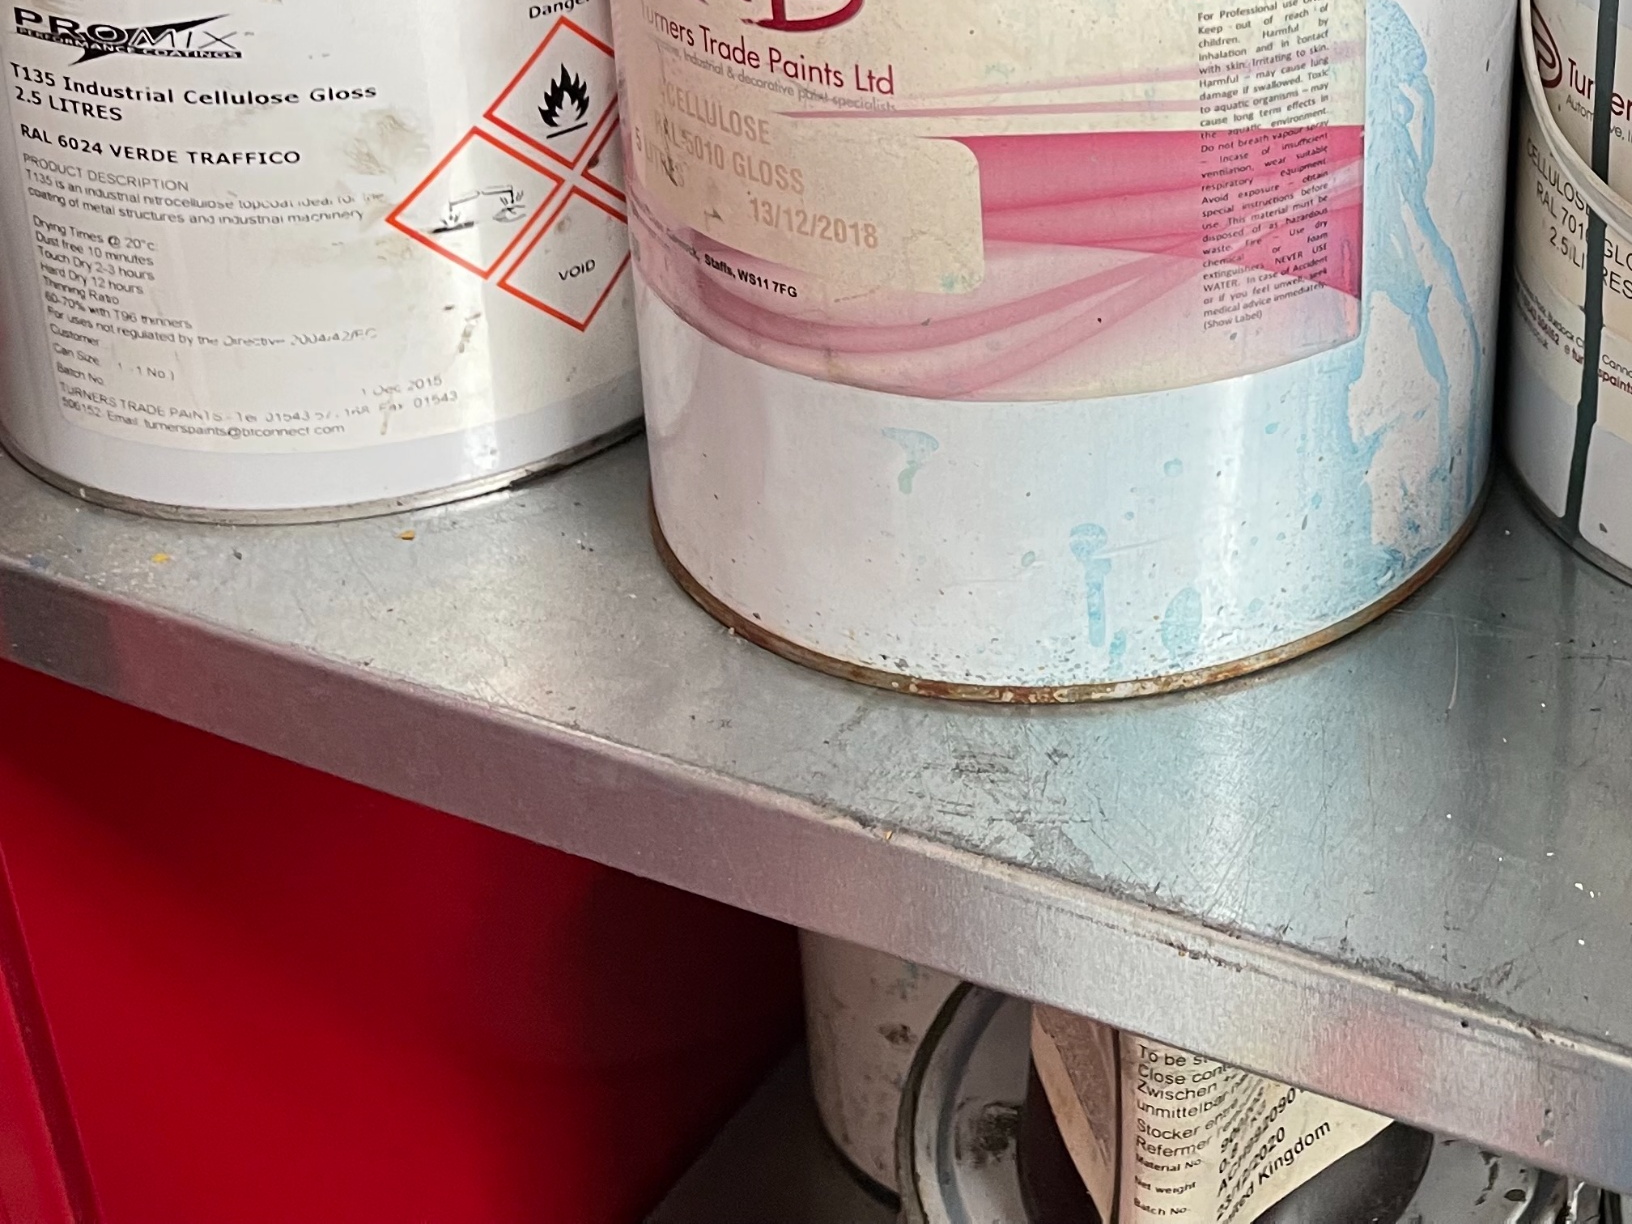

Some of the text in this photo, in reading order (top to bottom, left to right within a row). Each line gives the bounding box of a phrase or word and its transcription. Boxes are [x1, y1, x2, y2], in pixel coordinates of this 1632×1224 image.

[13, 7, 236, 49] PROMIX
[1198, 12, 1214, 22] For
[1219, 1, 1278, 19] Professional
[699, 25, 761, 69] Trade
[769, 47, 844, 88] Paints
[855, 64, 894, 95] Ltd
[10, 62, 377, 105] T135 Industrial Cellulose Gloss
[15, 86, 122, 122] 2.5 LITRES
[20, 123, 301, 166] RAL 6024 VERDE TRAFFICO
[23, 152, 190, 192] PRODUCT DESCRIPTION
[732, 151, 805, 196] GLOSS
[749, 197, 879, 249] 13/12/2018
[557, 258, 597, 283] VOID
[737, 269, 798, 298] WS11 7FG
[1203, 309, 1263, 330] (Show Label)
[1137, 1079, 1217, 1101] Zwischen
[1138, 1064, 1186, 1085] Close
[1136, 1118, 1198, 1140] Stocker
[1257, 1121, 1331, 1185] Kingdom
